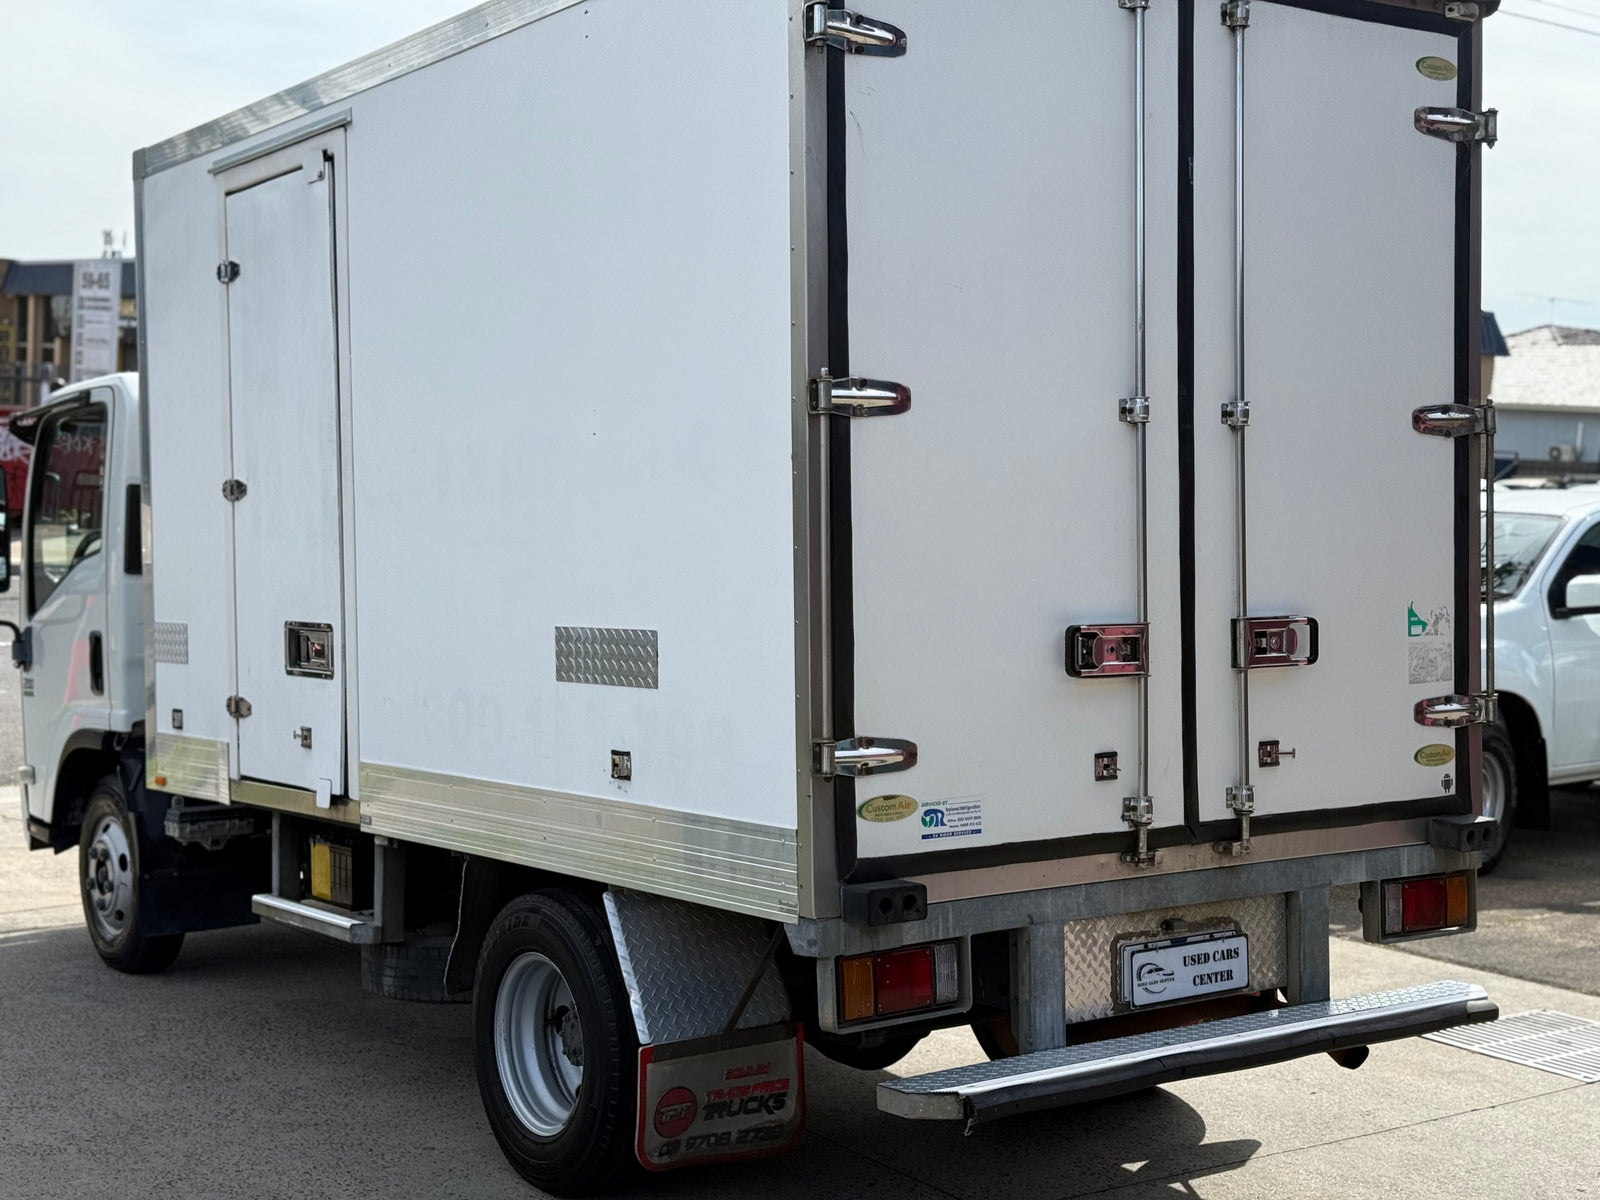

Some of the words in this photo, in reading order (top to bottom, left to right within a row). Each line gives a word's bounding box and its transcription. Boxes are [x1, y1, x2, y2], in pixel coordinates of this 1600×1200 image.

[1183, 952, 1210, 967] USED
[1212, 947, 1240, 962] CARS
[1192, 969, 1234, 987] CENTER
[702, 1092, 787, 1121] TRUCKS
